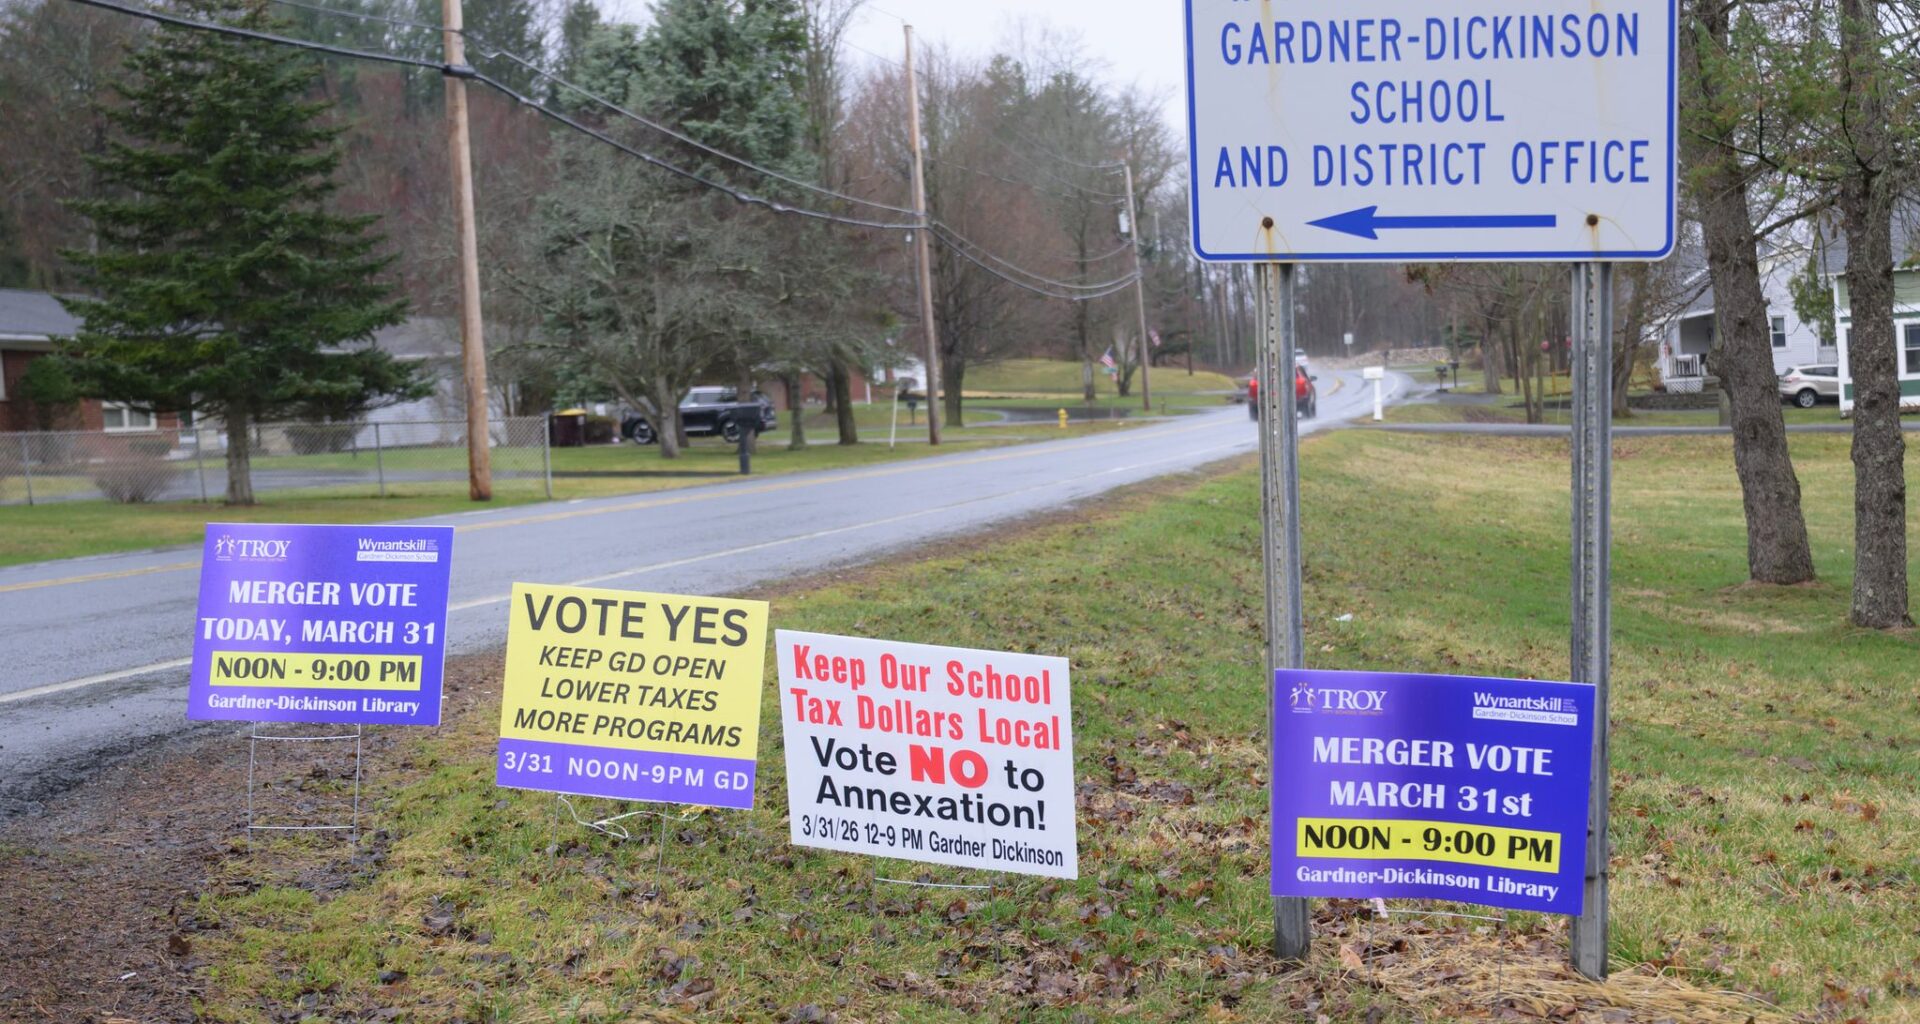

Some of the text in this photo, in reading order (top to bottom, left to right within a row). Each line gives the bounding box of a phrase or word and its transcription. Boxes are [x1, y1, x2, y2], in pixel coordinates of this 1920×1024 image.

[1221, 13, 1639, 65] GARDNER-DICKINSON
[1350, 79, 1505, 125] SCHOOL
[1214, 139, 1650, 188] AND DISTRICT OFFICE
[236, 539, 292, 558] TROY
[358, 538, 426, 552] Wynantskill
[229, 580, 418, 607] MERGER VOTE
[201, 617, 435, 645] TODAY, MARCH 31
[524, 593, 748, 647] VOTE YES
[216, 657, 286, 679] NOON
[312, 659, 370, 682] 9:00
[380, 661, 416, 683] PM
[539, 645, 726, 681] KEEP GD OPEN
[793, 644, 1051, 705] Keep Our School
[208, 693, 420, 717] Gardner-Dickinson Library
[540, 677, 719, 712] LOWER TAXES
[1318, 688, 1388, 711] TROY
[1473, 692, 1562, 712] Wynantskill
[514, 708, 742, 748] MORE PROGRAMS
[790, 687, 1060, 750] Tax Dollars Local
[1548, 714, 1576, 724] School
[503, 751, 749, 792] 3/31 NOON-9PM GD
[810, 736, 1045, 792] Vote NO to
[1313, 736, 1554, 777] MERGER VOTE
[816, 774, 1046, 831] Annexation!
[1330, 780, 1533, 817] MARCH 31st
[802, 814, 1063, 867] 3/31/26 12-9 PM Gardner Dickinson
[1304, 824, 1391, 850] NOON
[1423, 828, 1495, 856] 9:00
[1507, 836, 1553, 863] PM
[1296, 866, 1559, 902] Gardner-Dickinson Library
